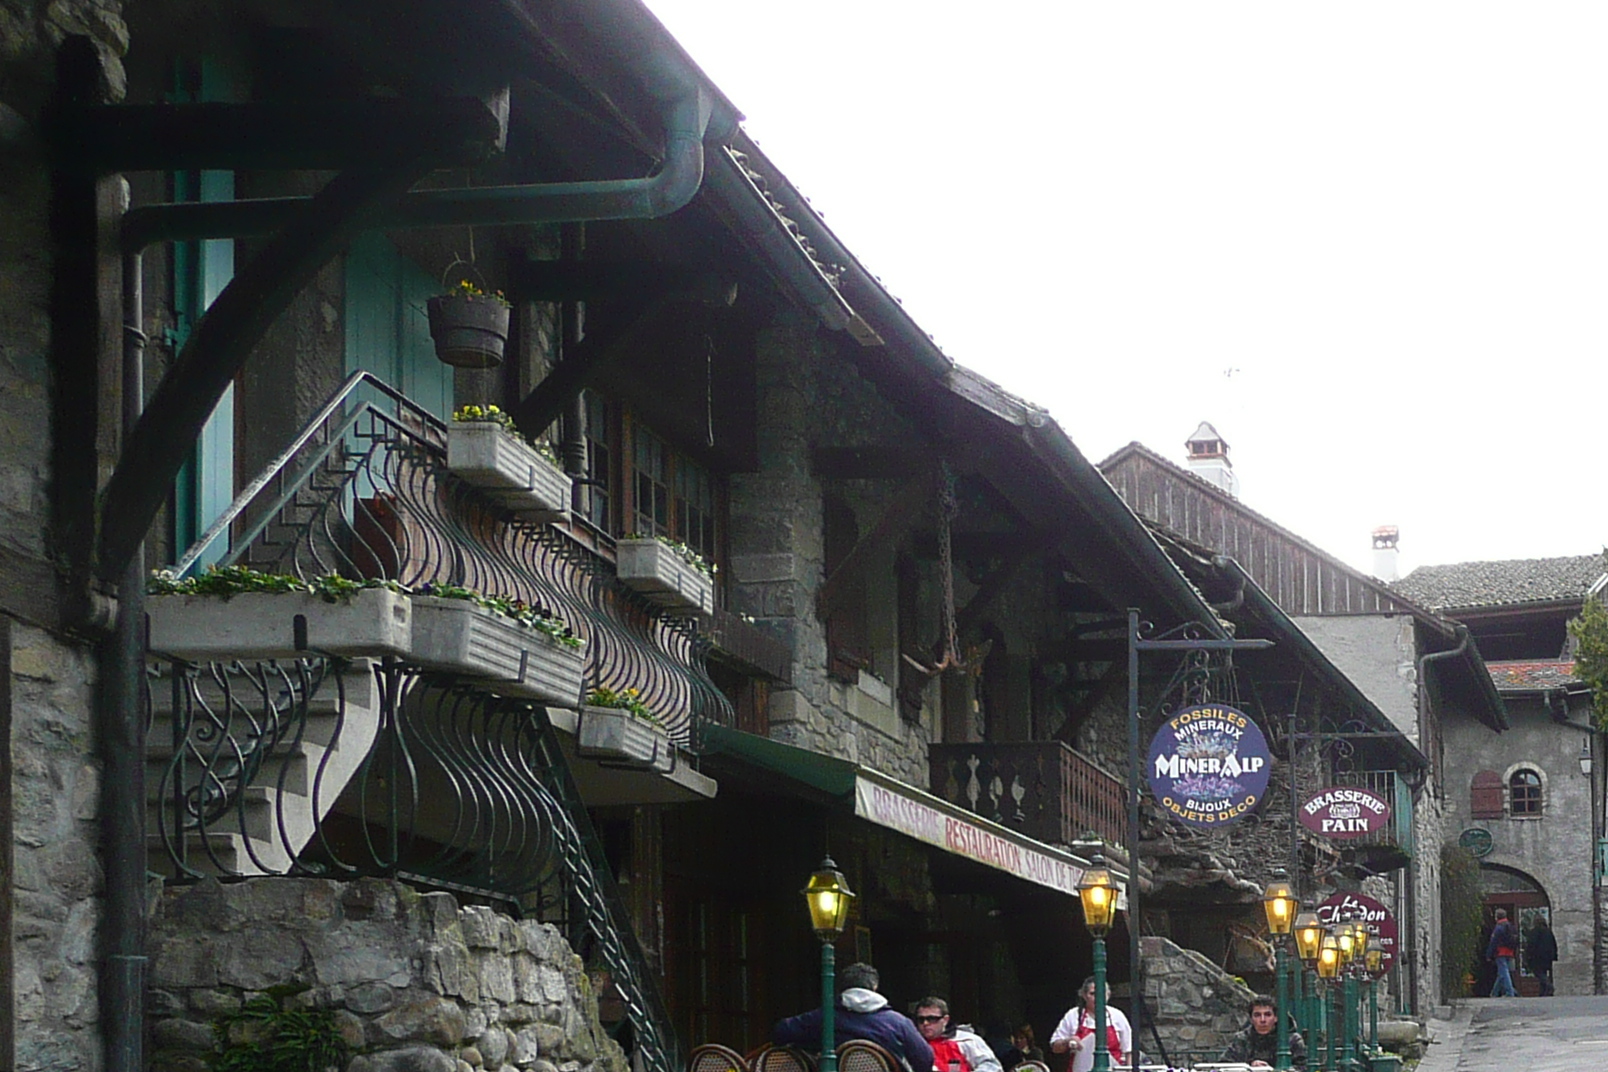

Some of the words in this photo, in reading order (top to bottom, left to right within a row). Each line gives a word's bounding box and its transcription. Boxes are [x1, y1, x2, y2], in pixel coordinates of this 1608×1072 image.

[1170, 708, 1248, 730] FOSSILES
[1173, 720, 1244, 741] MINERAUX
[1162, 796, 1215, 823] OBJETS
[1218, 794, 1256, 821] DECO
[1185, 798, 1233, 812] BIJOUX
[1304, 790, 1386, 816] BRASSERIE
[1321, 818, 1369, 832] PAIN
[873, 785, 940, 844] BRASSERIE
[944, 817, 1022, 874] RESTAURATION
[1025, 849, 1054, 886] SALON
[1055, 861, 1067, 888] DE
[1341, 895, 1359, 909] Le
